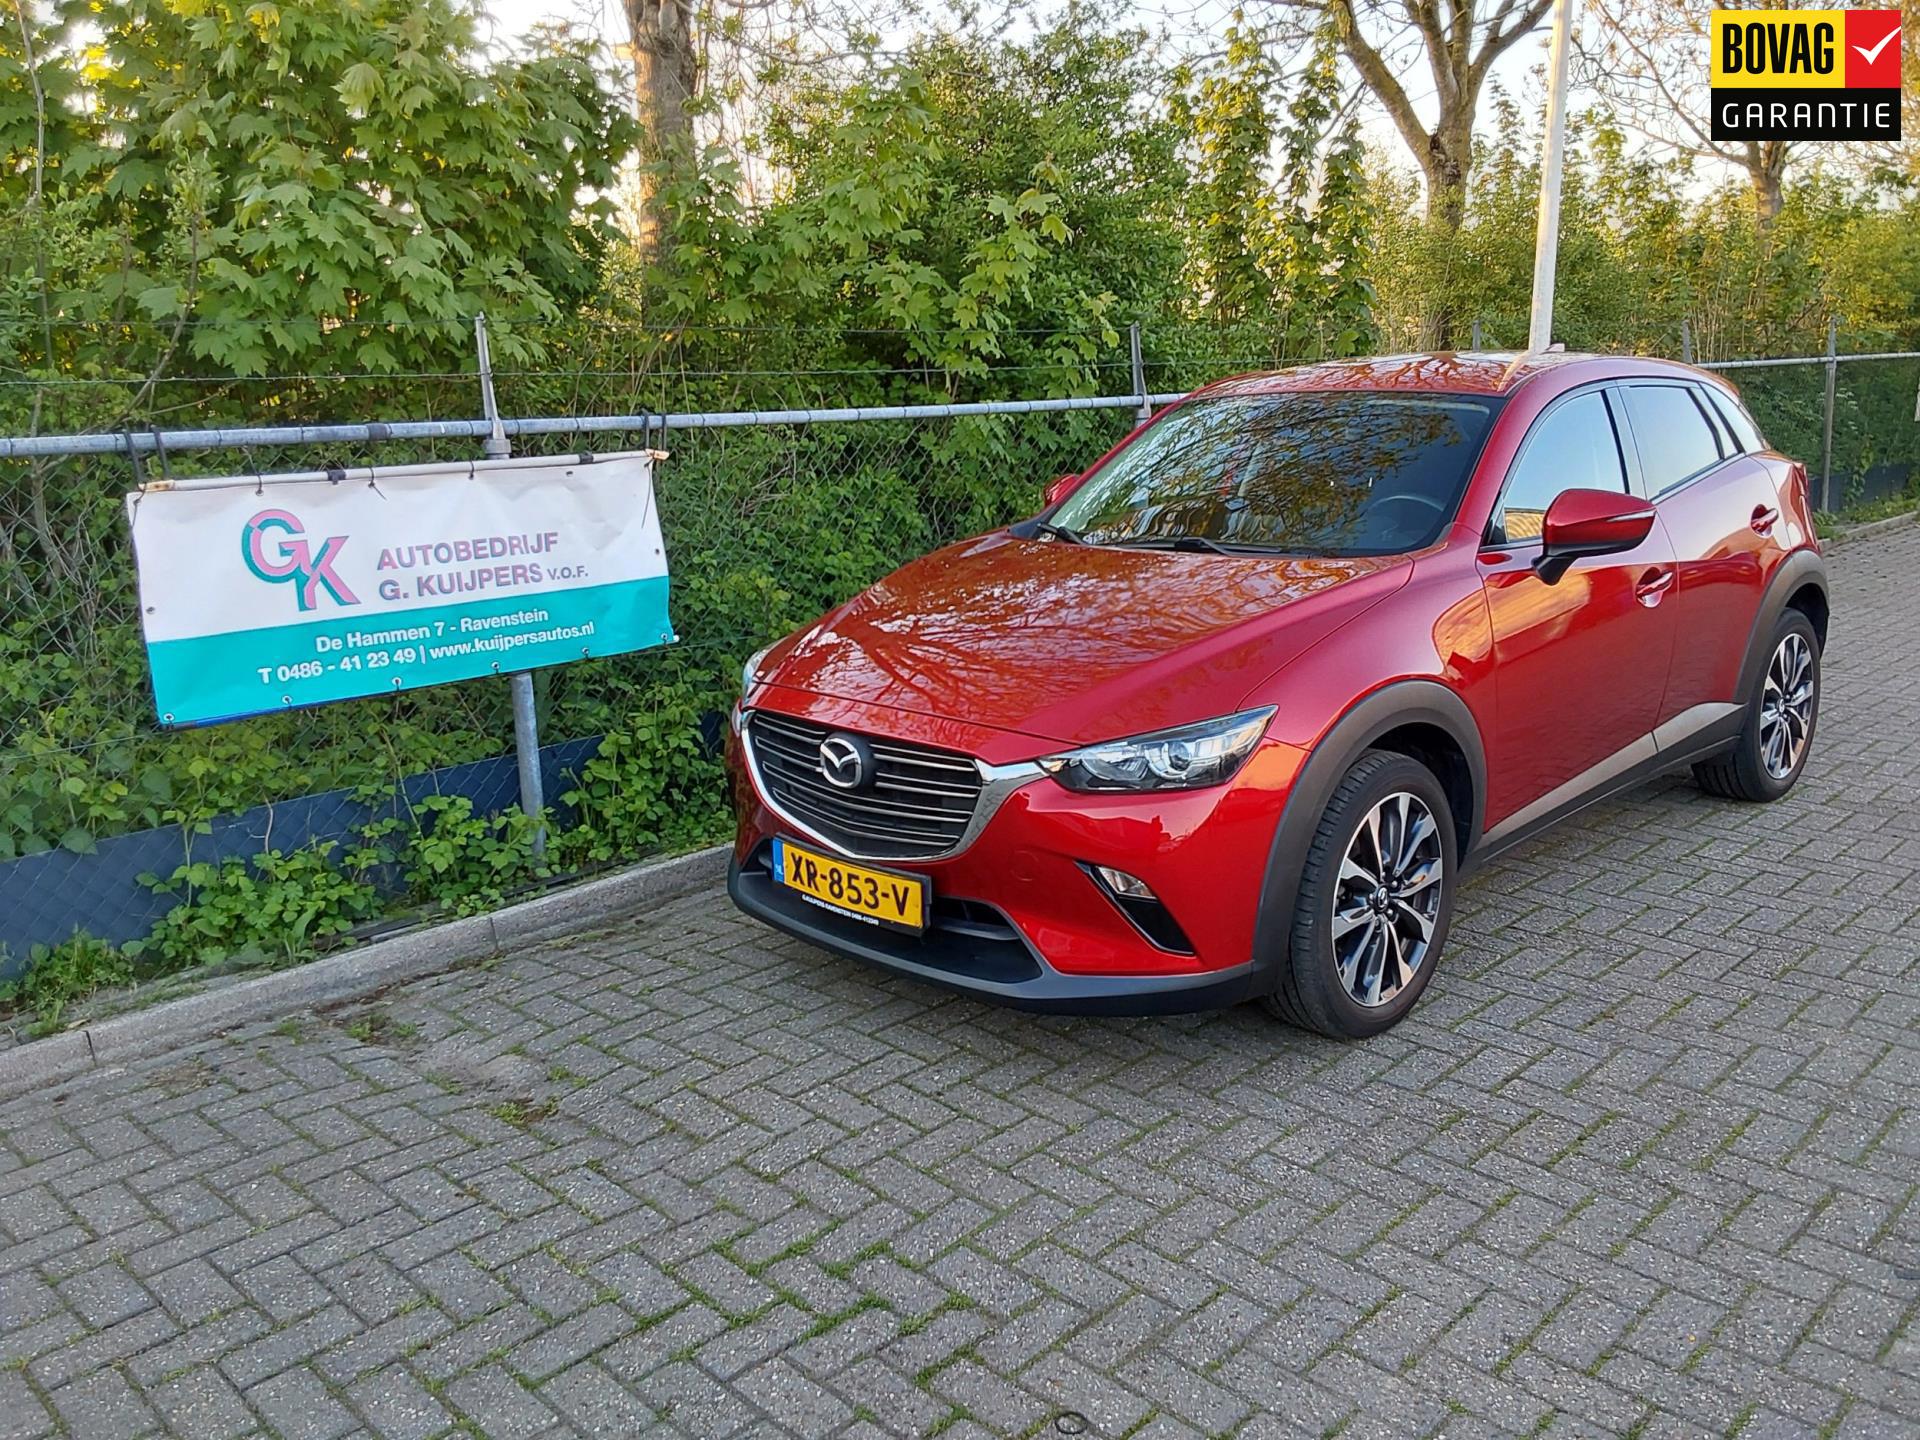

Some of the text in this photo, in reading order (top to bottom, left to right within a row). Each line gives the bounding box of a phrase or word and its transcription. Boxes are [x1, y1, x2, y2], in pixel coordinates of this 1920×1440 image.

[241, 508, 361, 612] GK
[377, 532, 558, 571] AUTOBEDRIJF
[379, 562, 589, 601] G. KUIJPERS V.O.F.
[257, 667, 273, 684] T
[277, 660, 323, 682] 0486
[340, 655, 362, 671] 41
[366, 651, 390, 668] 23
[393, 647, 417, 664] 49
[429, 620, 595, 659] www.kuijpersautos.nl
[316, 636, 343, 653] De
[346, 626, 431, 648] Hammen
[434, 621, 445, 637] 7
[460, 608, 549, 633] Ravenstein
[790, 851, 909, 917] XR-853-V
